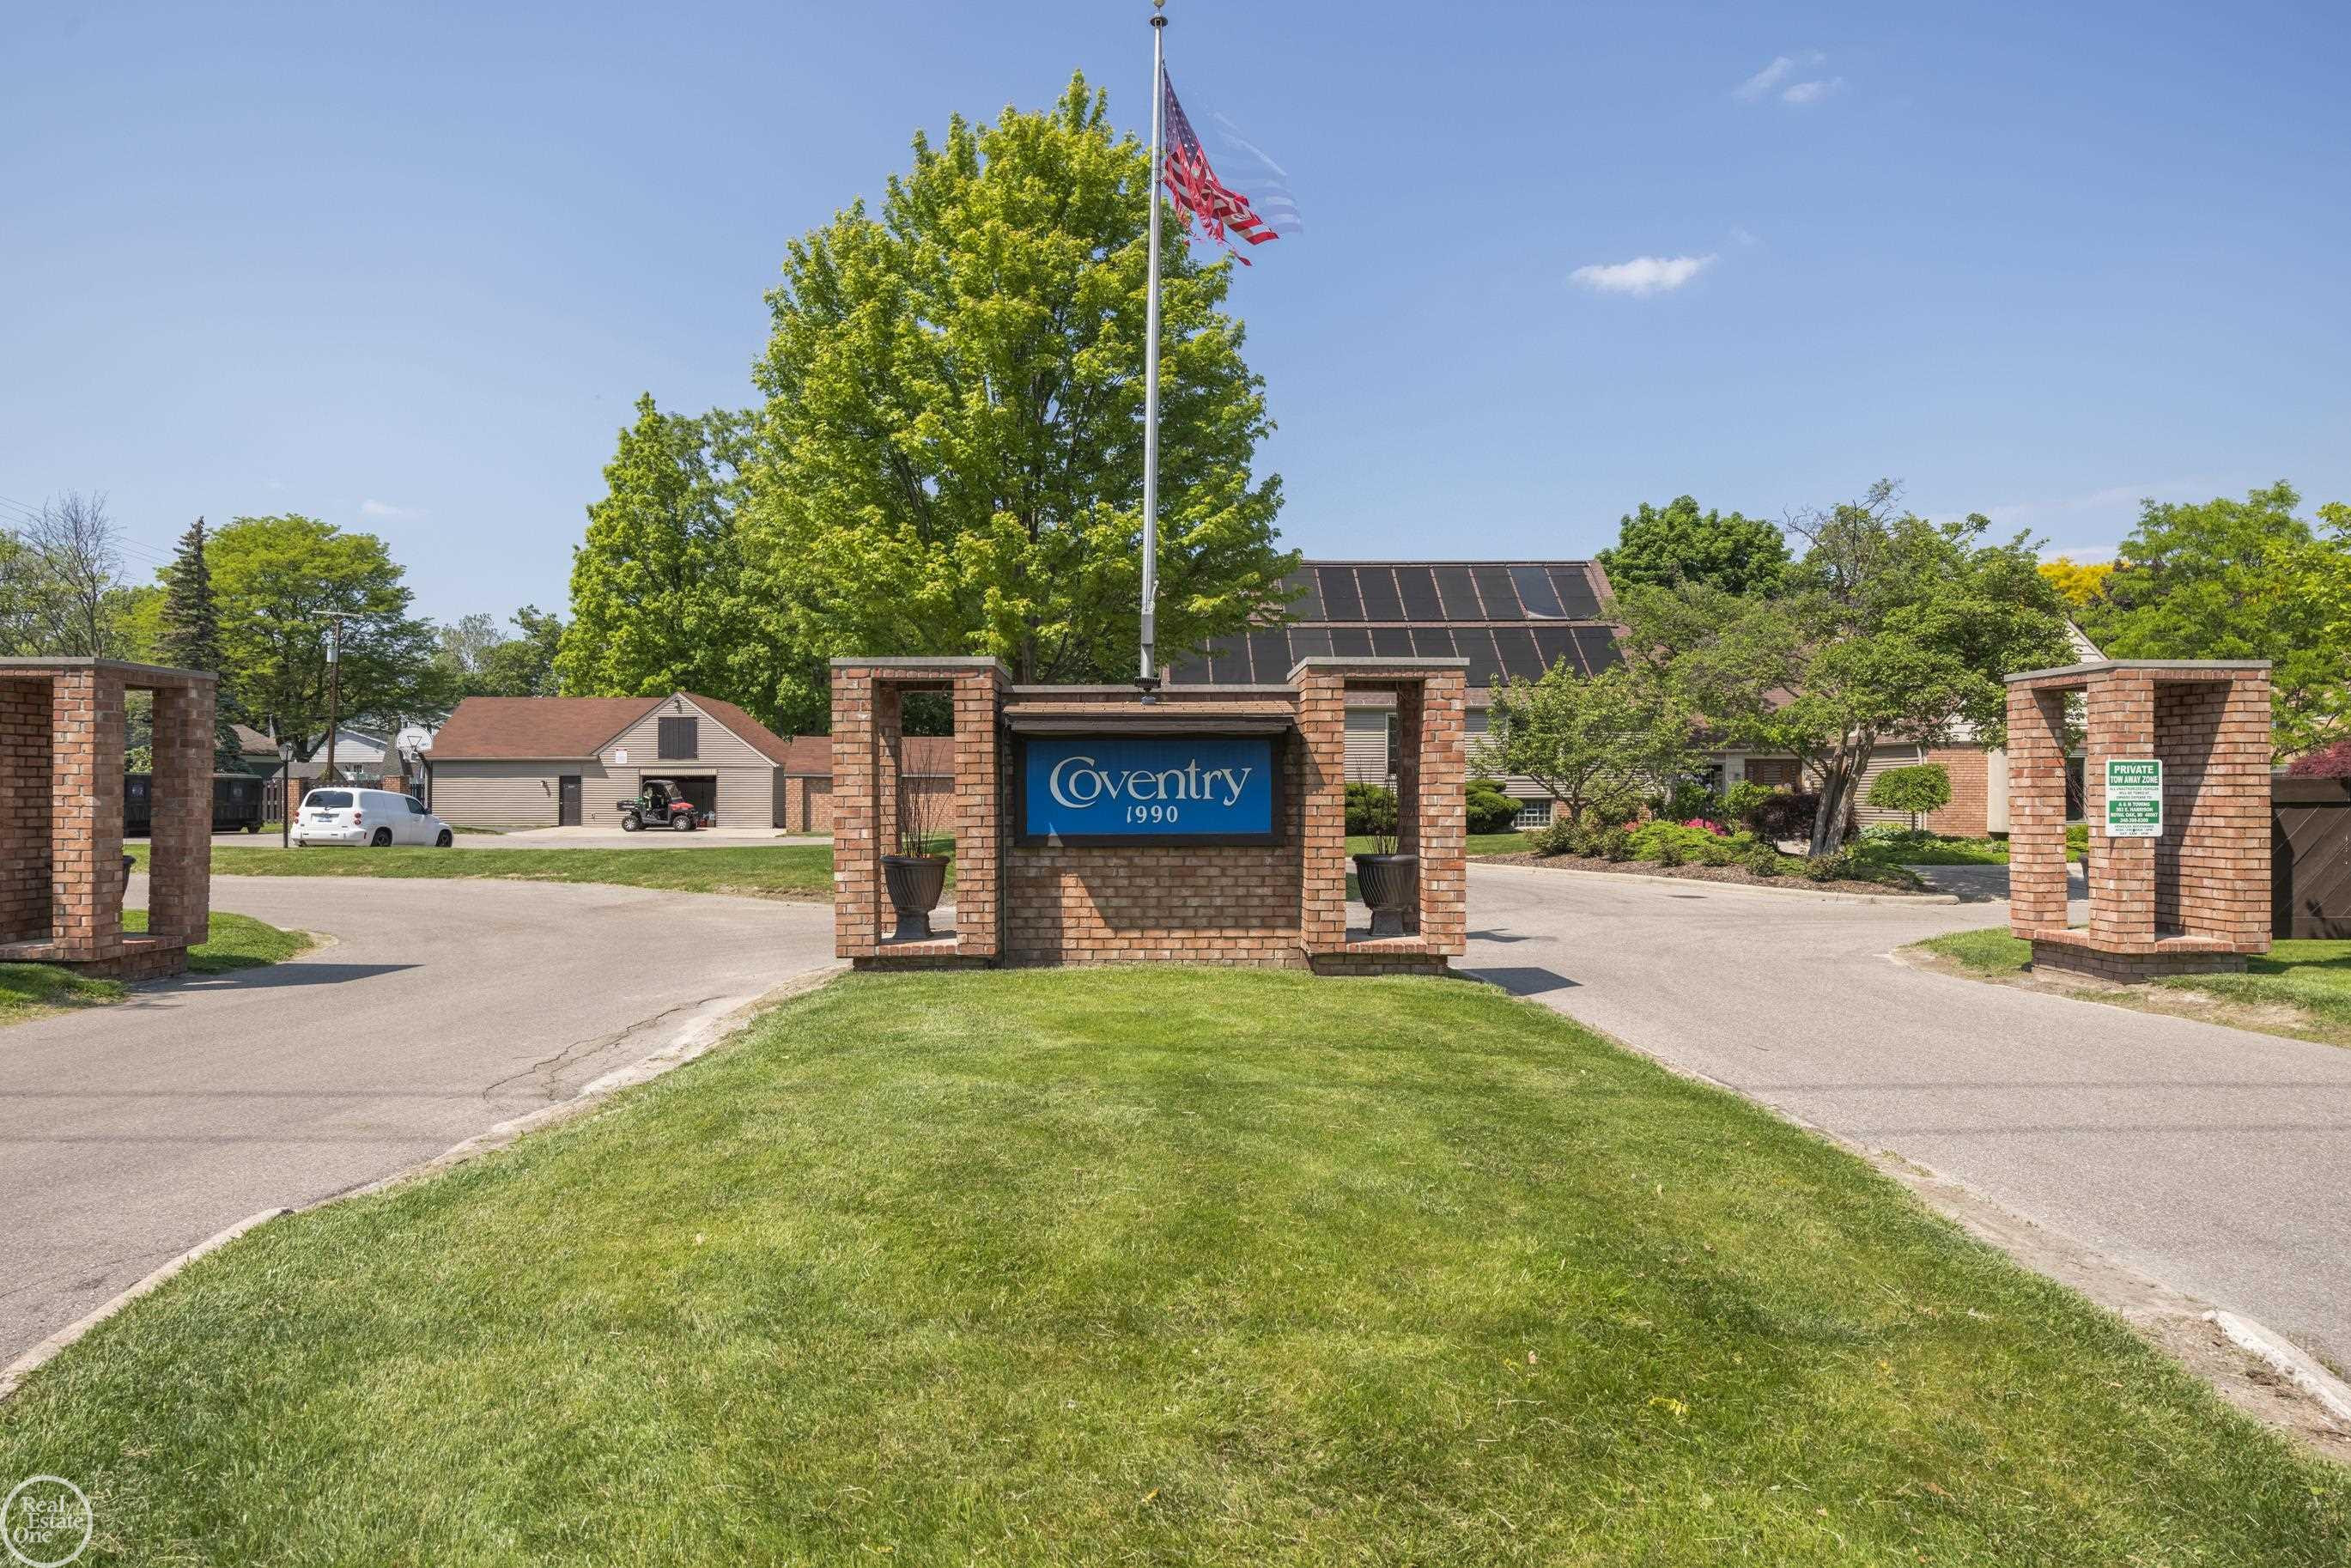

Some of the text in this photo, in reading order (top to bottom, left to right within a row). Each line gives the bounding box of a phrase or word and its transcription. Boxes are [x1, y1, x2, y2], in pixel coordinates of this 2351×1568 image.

[2114, 765, 2154, 774] PRIVATE
[1048, 756, 1253, 809] Coventry
[1126, 805, 1179, 824] 1990
